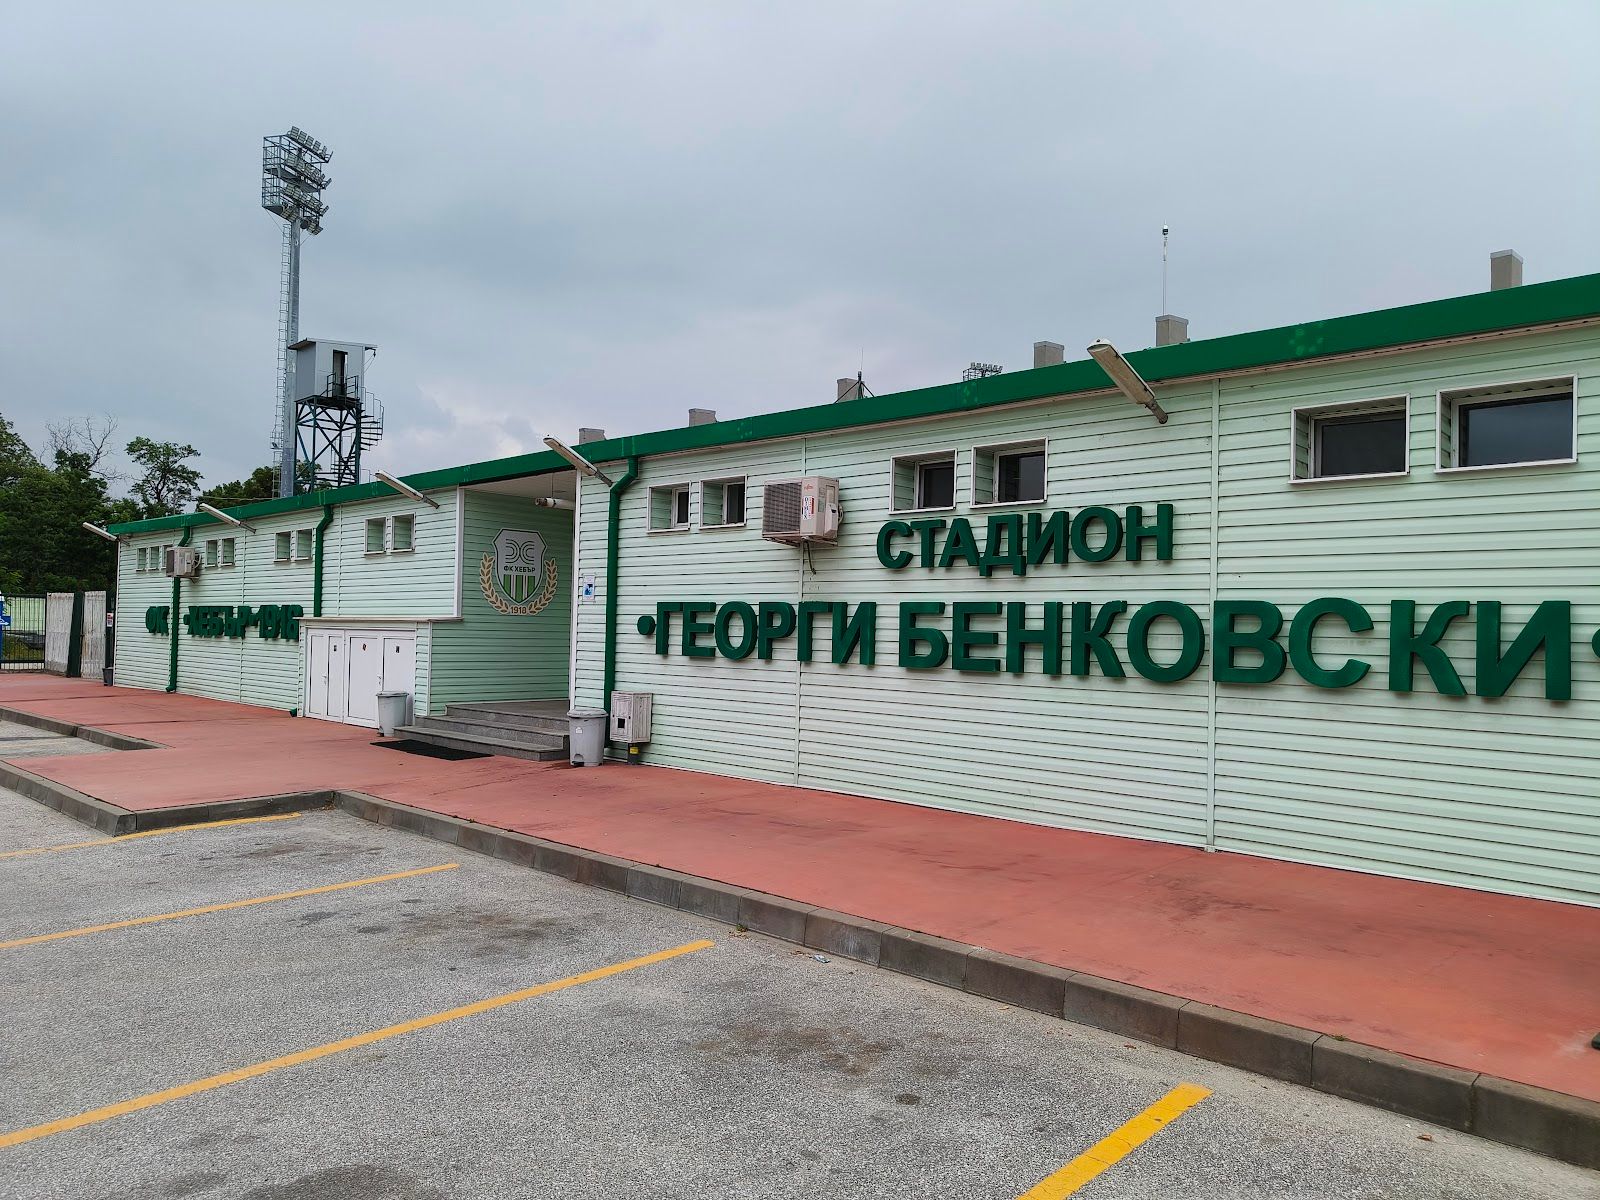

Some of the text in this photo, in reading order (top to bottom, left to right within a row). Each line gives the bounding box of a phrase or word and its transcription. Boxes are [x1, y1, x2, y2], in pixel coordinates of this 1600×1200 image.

[876, 503, 1174, 576] СТАДИОН
[510, 605, 527, 614] 1918
[655, 597, 1571, 700] ГЕОРГИ БЕНКОВСКИ
